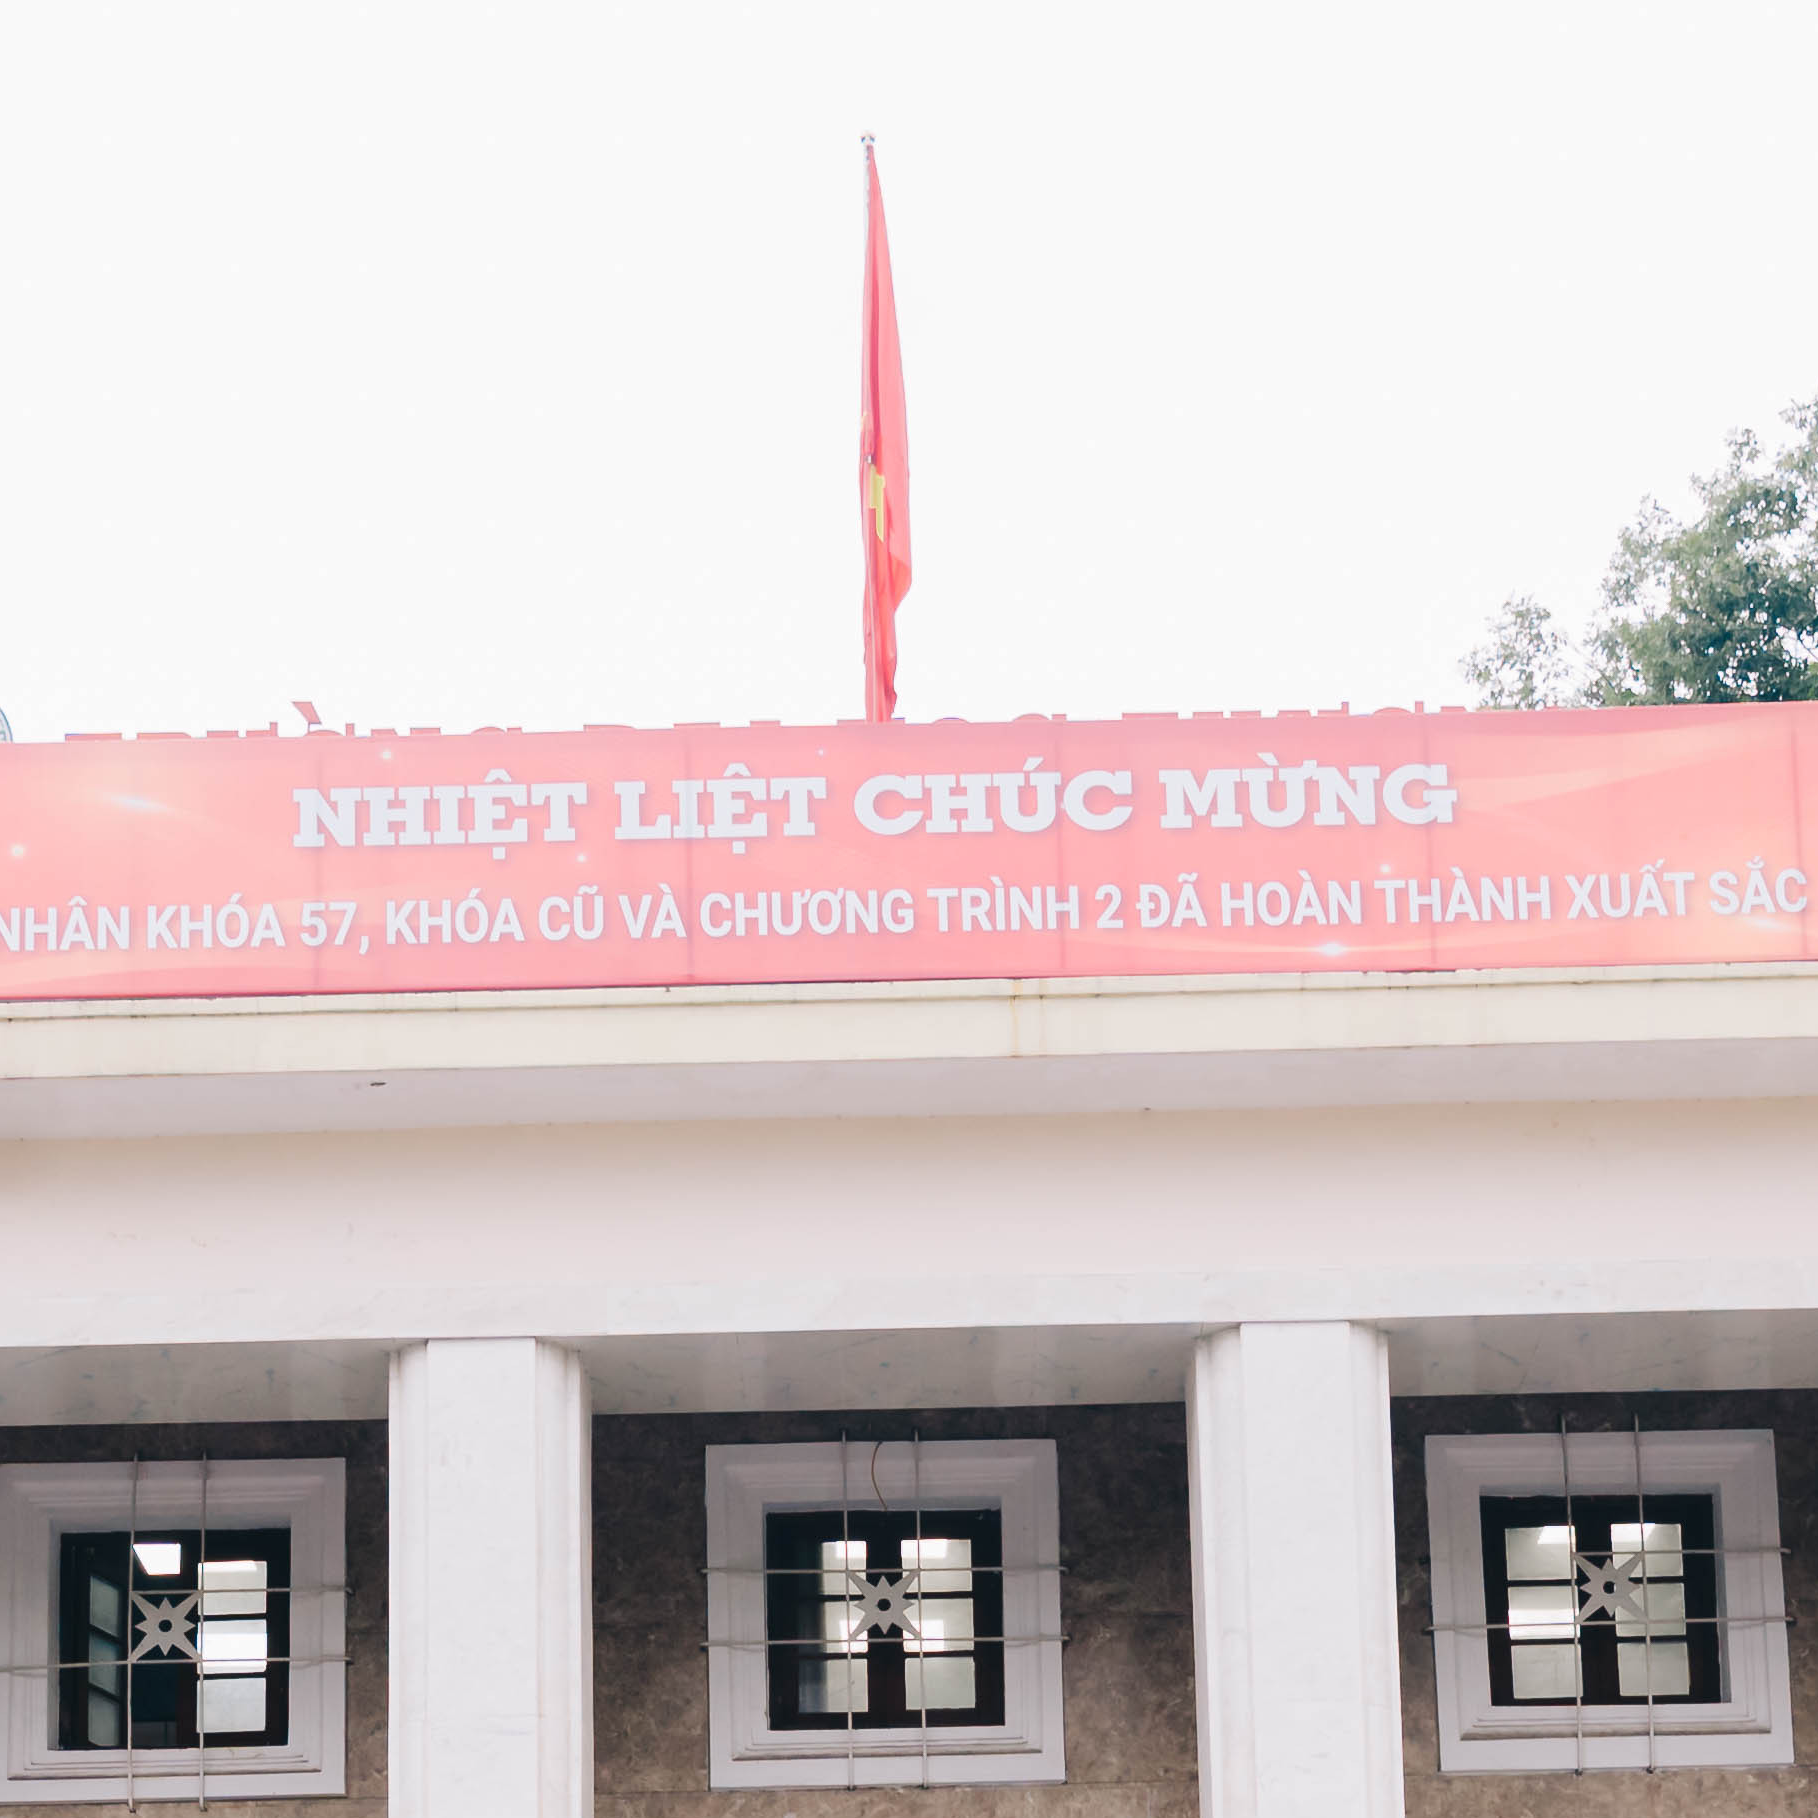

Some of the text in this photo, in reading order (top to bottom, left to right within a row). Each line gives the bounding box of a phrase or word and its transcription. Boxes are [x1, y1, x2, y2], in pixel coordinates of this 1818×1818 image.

[293, 752, 1457, 860] NHIỆT LIỆT CHÚC MỪNG
[147, 892, 285, 950] KHÓA
[300, 901, 369, 955] 57,
[386, 887, 525, 945] KHÓA
[539, 884, 603, 941] CŨ
[618, 882, 687, 939] VÀ
[701, 886, 914, 938] CHƯƠNG
[927, 876, 1079, 932] TRÌNH
[1095, 885, 1124, 929] 2
[1135, 872, 1207, 929] ĐÃ
[1221, 870, 1361, 927] HOÀN
[1374, 864, 1551, 924] THÀNH
[1565, 858, 1696, 920] XUẤT
[1707, 850, 1807, 915] SẮC
